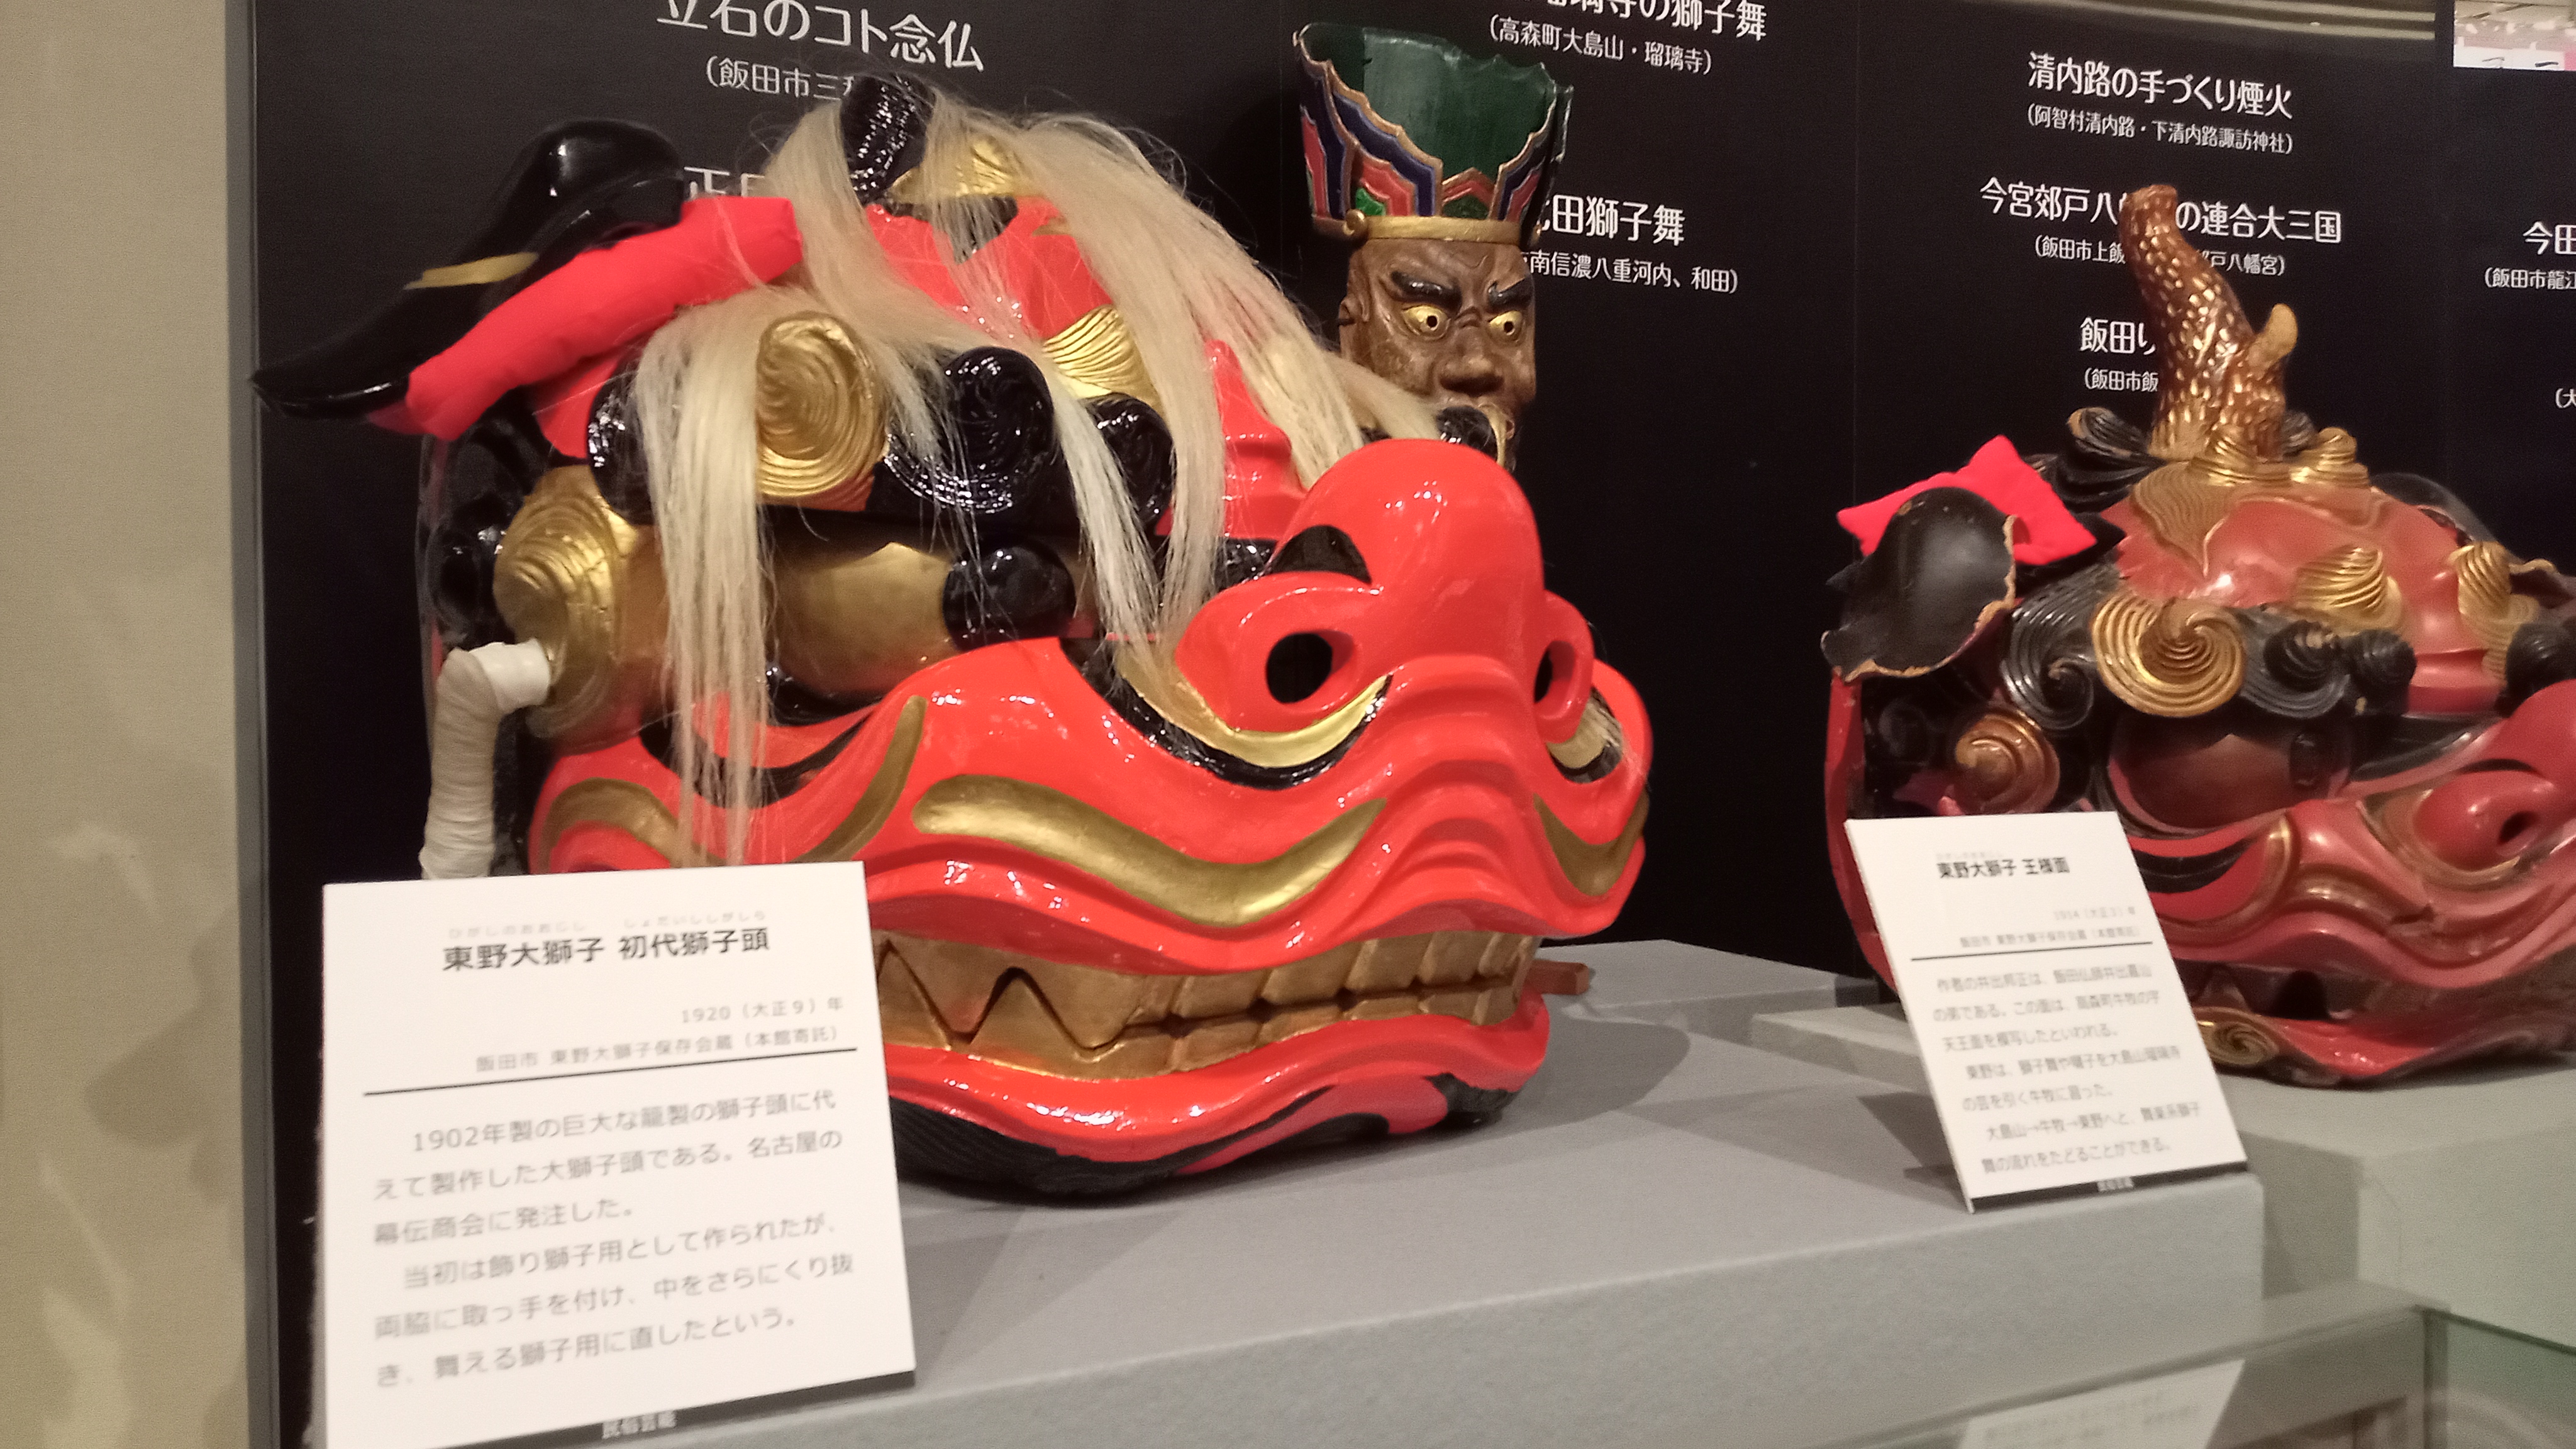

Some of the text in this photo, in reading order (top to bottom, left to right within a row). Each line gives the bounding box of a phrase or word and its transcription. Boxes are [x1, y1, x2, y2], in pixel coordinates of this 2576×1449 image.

[657, 0, 984, 72] 立石のコト念仏
[1490, 14, 1712, 74] (高森町大島山・瑠璃寺)
[1547, 0, 1767, 41] の獅子舞
[2028, 52, 2293, 119] 清内路の手づくり煙火
[2028, 104, 2293, 154] (阿智村清内路・下清内路諏訪神社)
[1538, 194, 1685, 246] 田獅子舞
[1521, 250, 1738, 294] 南信濃八重河内、和田)
[443, 927, 770, 971] 東野大獅子 初代獅子頭
